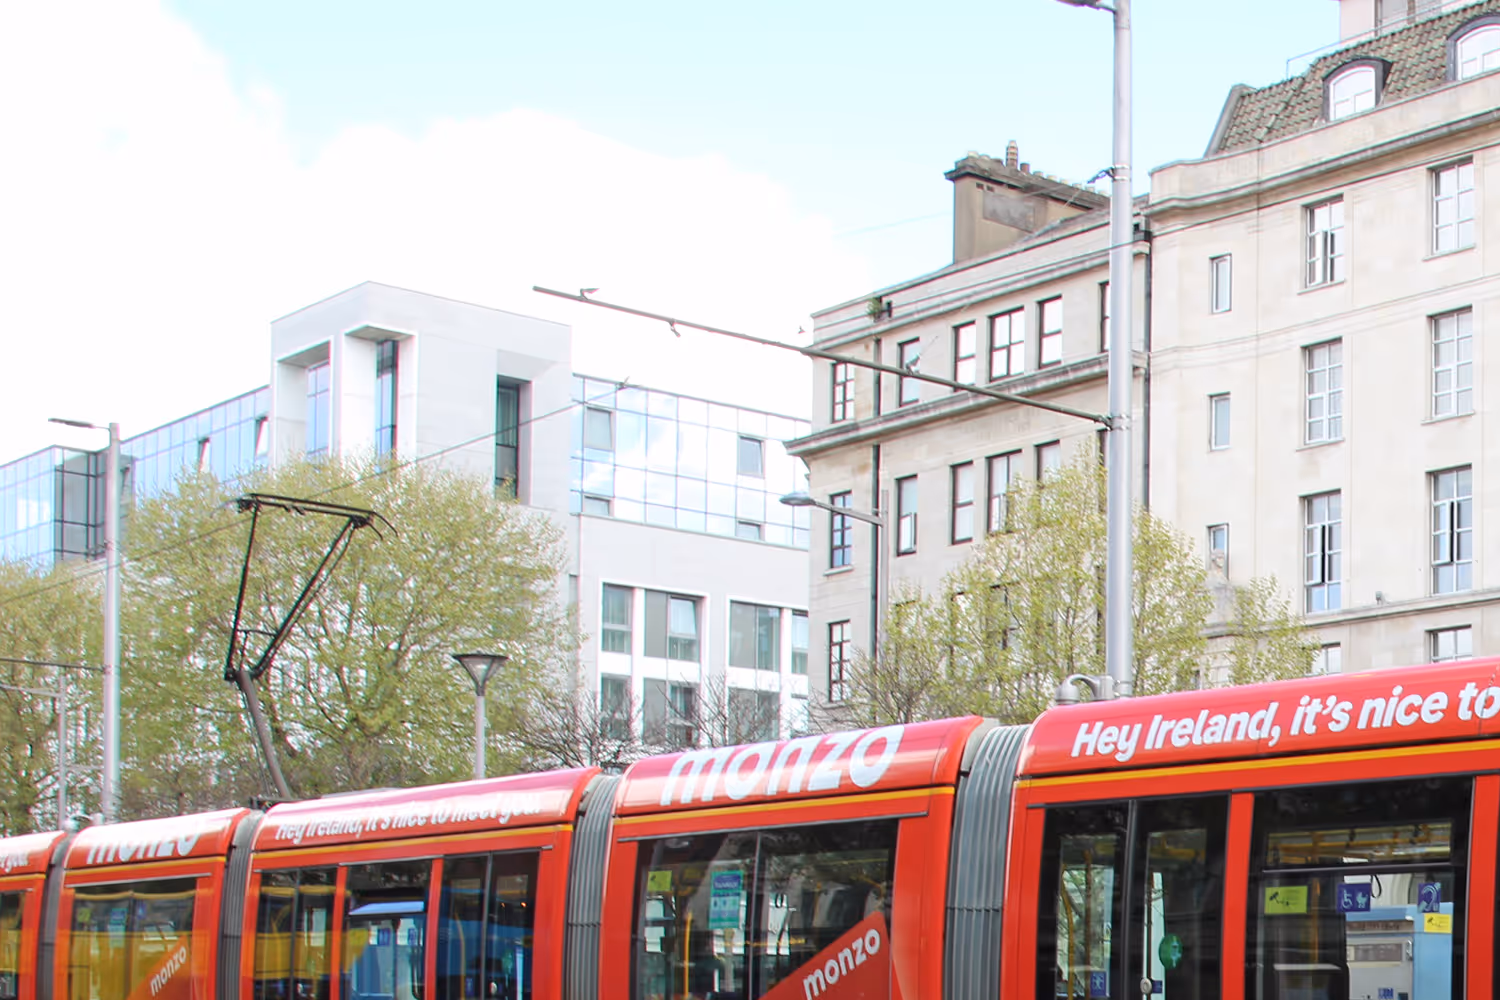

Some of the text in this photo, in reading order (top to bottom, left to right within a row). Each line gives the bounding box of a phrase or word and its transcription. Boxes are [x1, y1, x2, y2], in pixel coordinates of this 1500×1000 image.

[1071, 721, 1141, 762] Hey
[1144, 702, 1280, 748] Ireland,
[1357, 685, 1444, 726] nice
[660, 725, 906, 807] monzo
[150, 945, 188, 997] monzo
